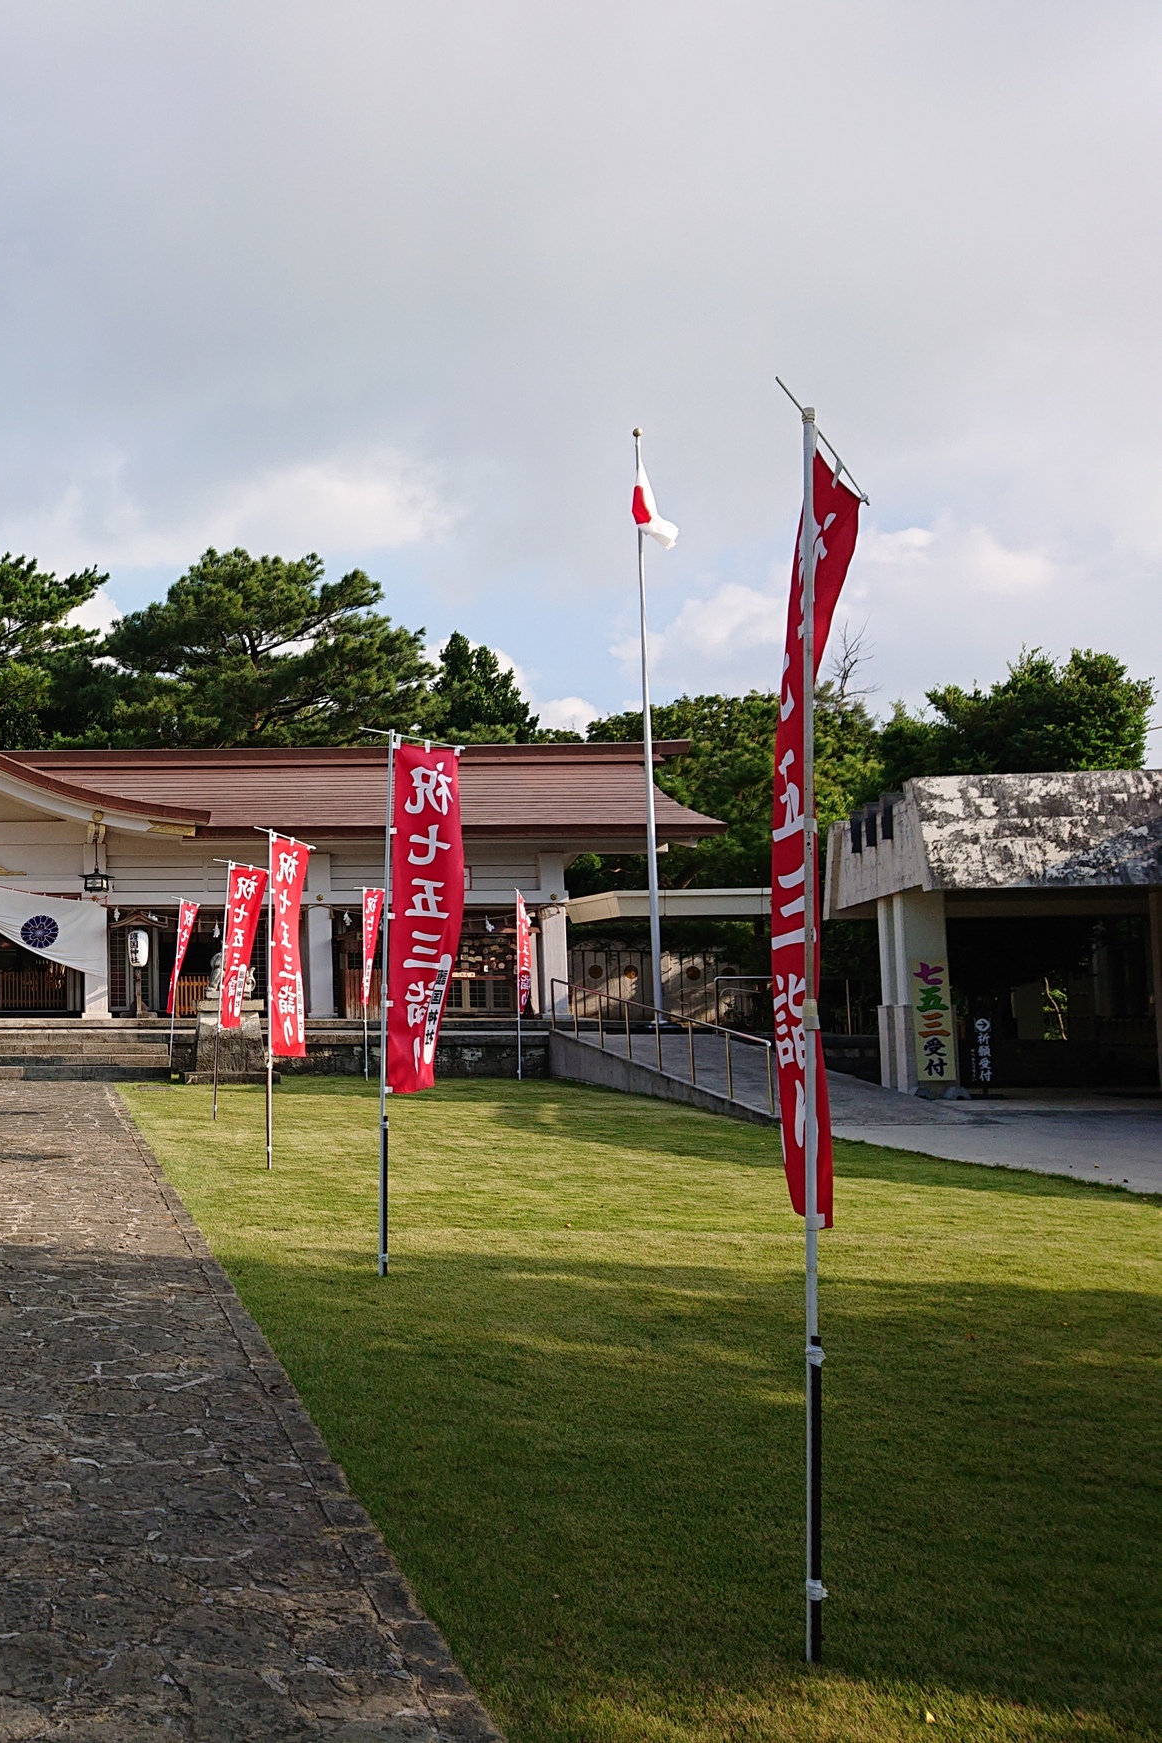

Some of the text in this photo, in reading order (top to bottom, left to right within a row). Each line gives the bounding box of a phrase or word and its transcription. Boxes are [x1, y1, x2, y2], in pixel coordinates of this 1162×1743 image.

[130, 932, 140, 964] 護国神社
[913, 962, 951, 1077] 七五三受付
[977, 1032, 993, 1082] 祈願受付
